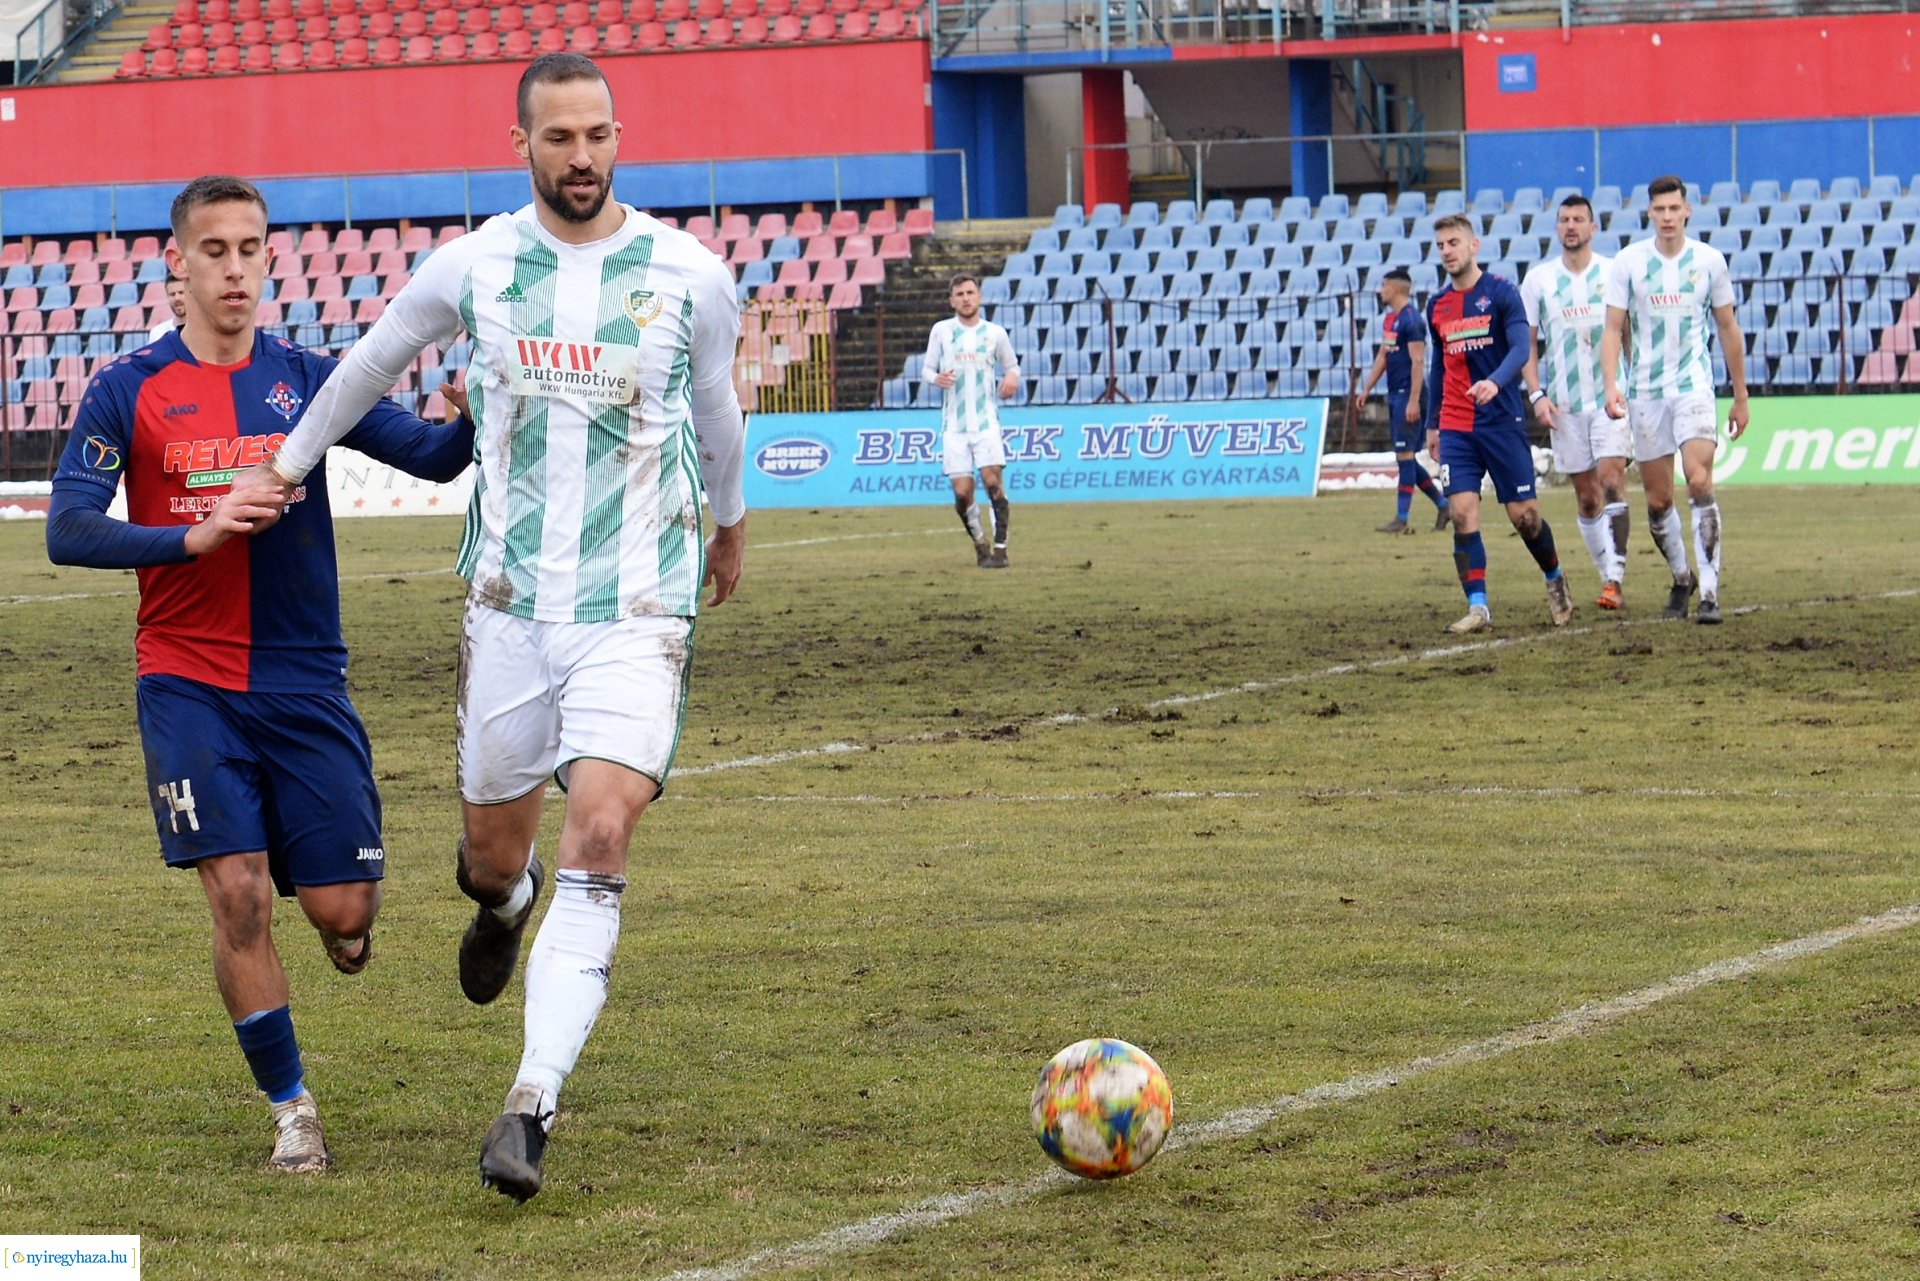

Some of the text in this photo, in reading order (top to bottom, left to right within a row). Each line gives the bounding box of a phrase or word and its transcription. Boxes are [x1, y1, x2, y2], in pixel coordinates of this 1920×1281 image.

[517, 339, 602, 371] WKW
[523, 366, 627, 389] automotive
[540, 383, 625, 399] WKW Hungaria Kft.
[1079, 414, 1307, 460] MŰVEK
[164, 432, 288, 473] REVES
[189, 472, 225, 485] ALWAYS
[1009, 469, 1036, 489] ÉS
[1043, 468, 1174, 489] GÉPELEMEK
[1182, 464, 1301, 487] GYÁRTÁSA
[356, 847, 384, 860] JAKO
